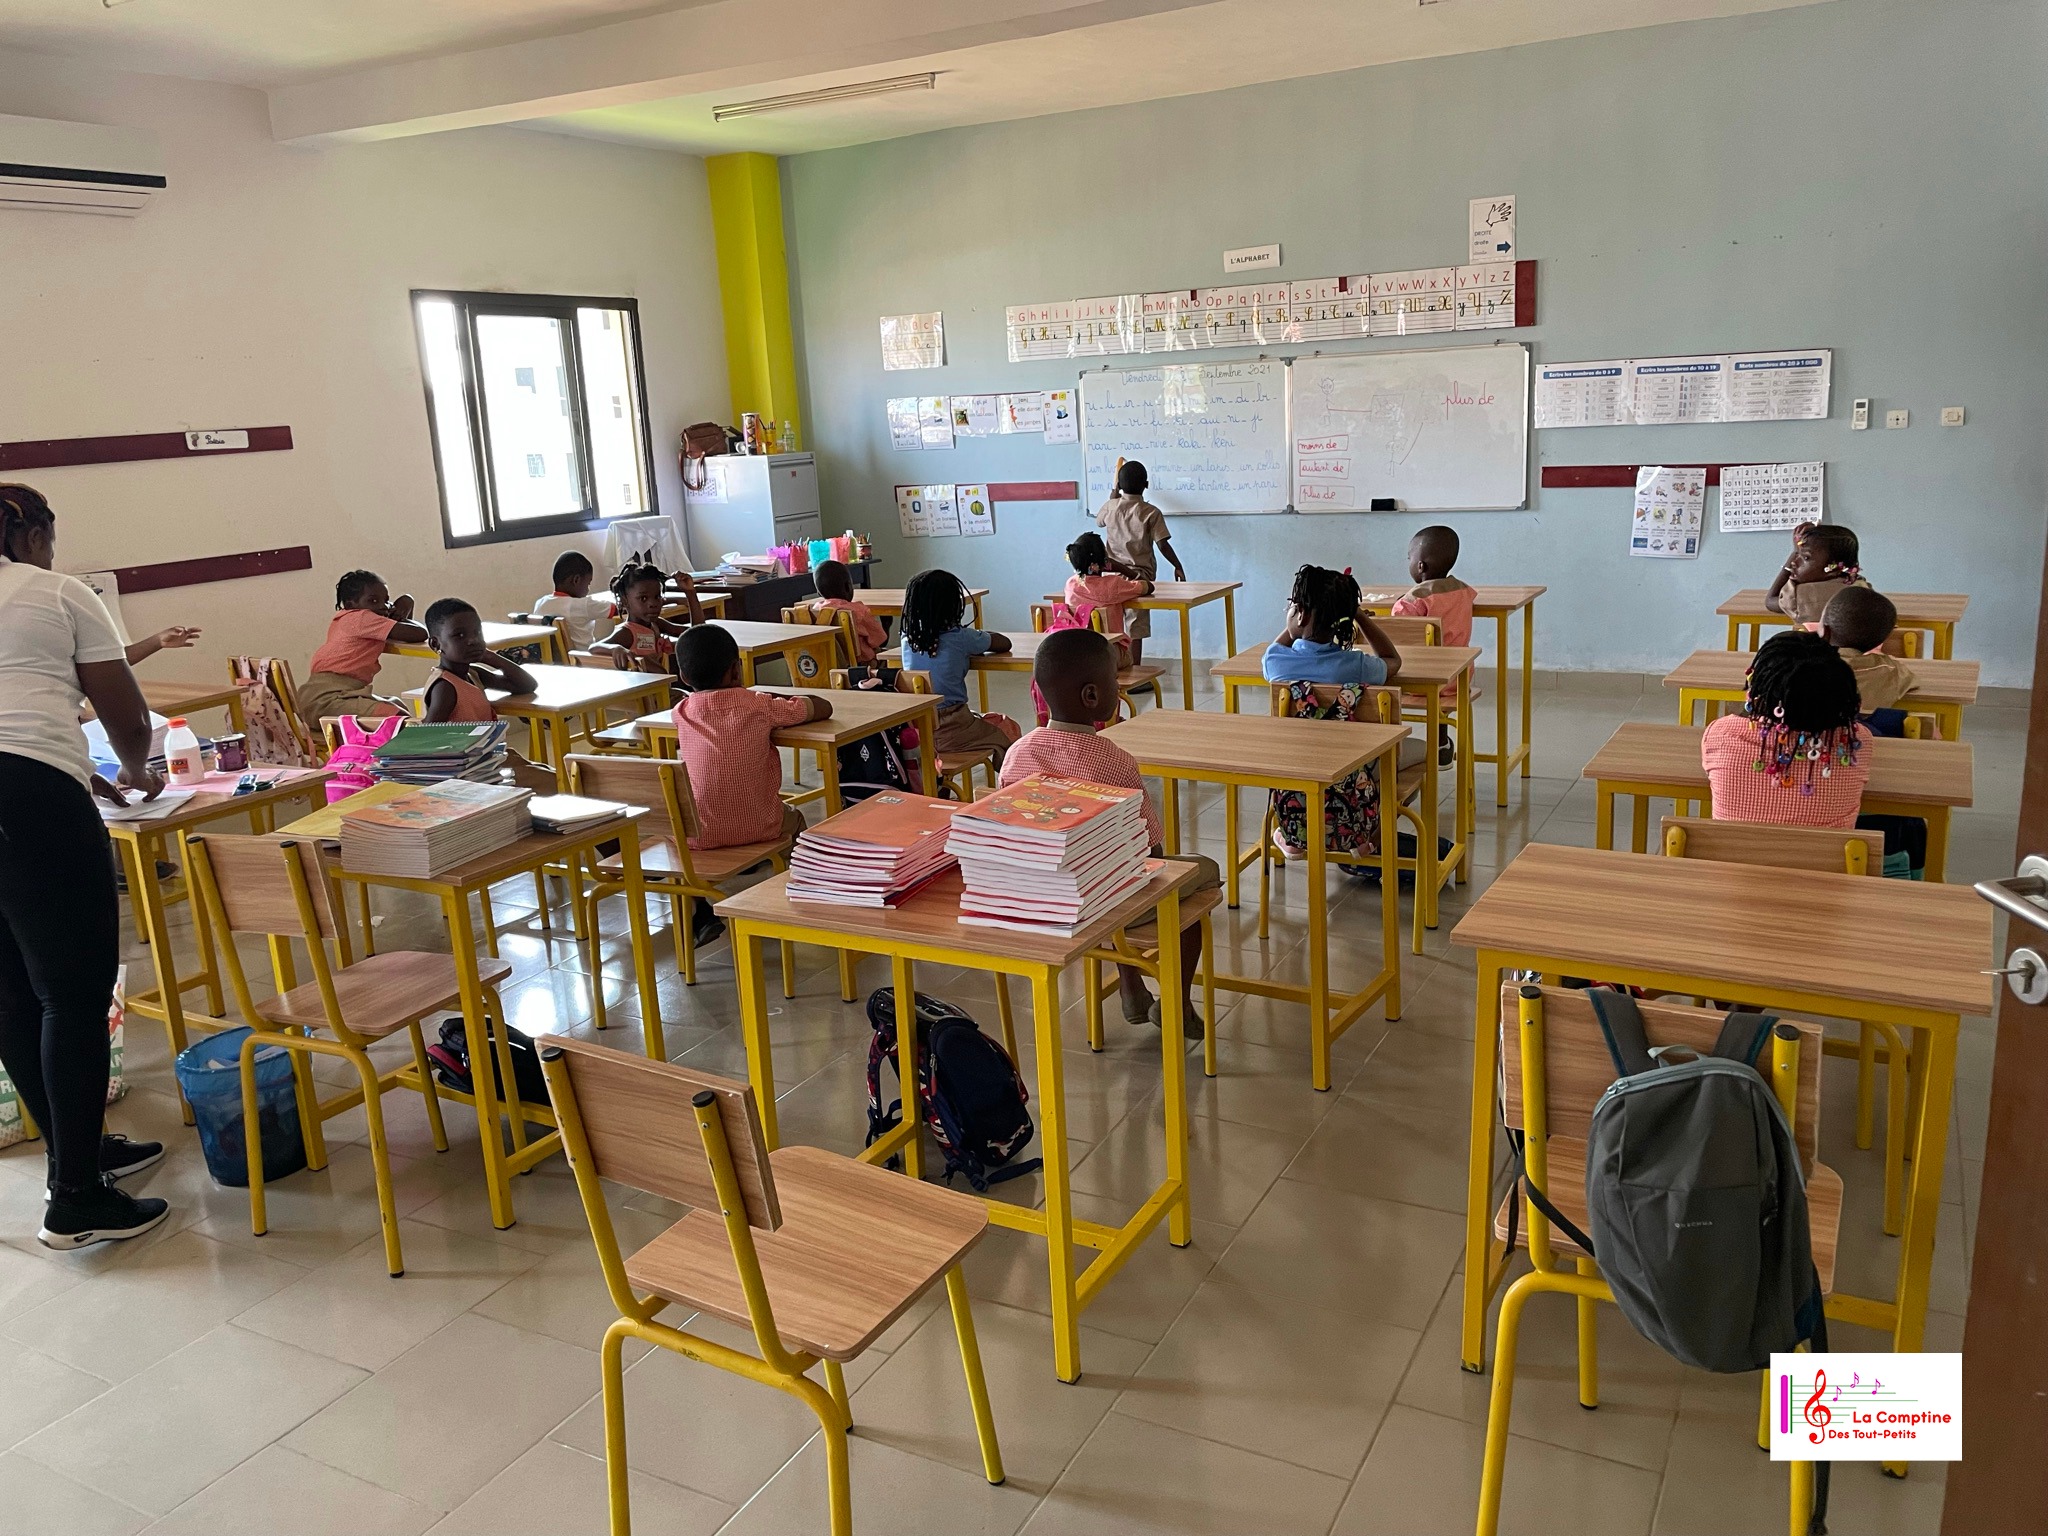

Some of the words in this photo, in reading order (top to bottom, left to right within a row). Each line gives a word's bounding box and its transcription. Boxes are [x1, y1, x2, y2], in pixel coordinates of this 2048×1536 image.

[1230, 254, 1269, 264] L'ALPHABET
[1019, 313, 1025, 321] G
[1042, 311, 1048, 319] H
[1086, 307, 1089, 316] J
[1100, 306, 1104, 314] k
[1156, 301, 1165, 310] M
[1182, 299, 1188, 308] N
[1207, 297, 1214, 306] O
[1216, 298, 1221, 307] p
[1228, 295, 1233, 304] P
[1240, 297, 1246, 306] q
[1279, 291, 1285, 300] R
[1306, 289, 1311, 299] S
[1360, 284, 1367, 294] U
[1386, 282, 1393, 291] V
[1412, 280, 1424, 289] W
[1443, 277, 1450, 287] X
[1460, 277, 1466, 287] y
[1473, 274, 1480, 284] Y
[1503, 271, 1510, 281] Z
[1248, 364, 1270, 375] 2021
[1441, 381, 1473, 420] plus
[1478, 382, 1494, 405] de
[1326, 439, 1337, 448] de
[1302, 462, 1329, 471] autant
[1333, 461, 1344, 472] de
[1302, 485, 1320, 501] plus
[1323, 486, 1336, 499] de
